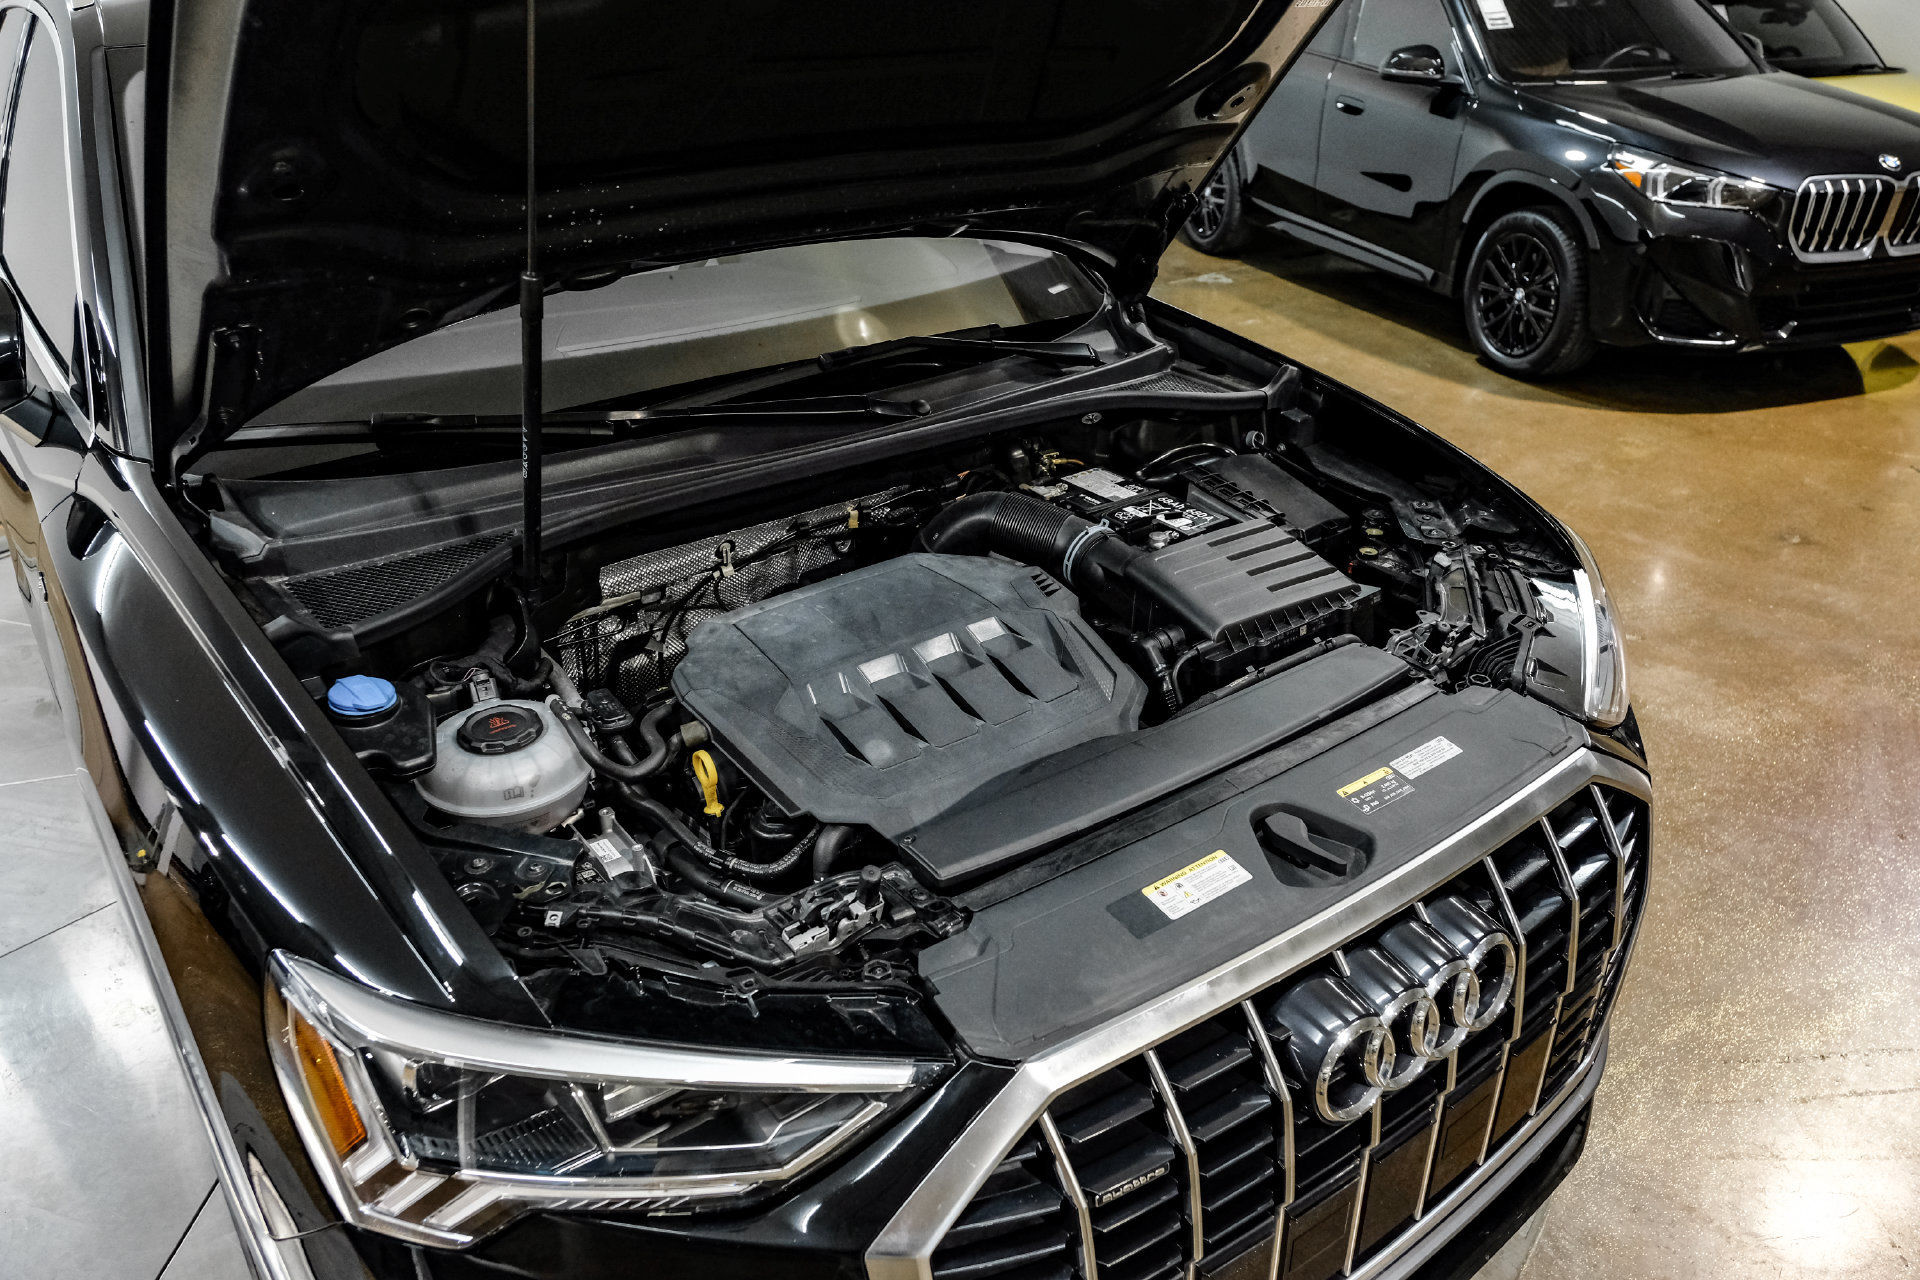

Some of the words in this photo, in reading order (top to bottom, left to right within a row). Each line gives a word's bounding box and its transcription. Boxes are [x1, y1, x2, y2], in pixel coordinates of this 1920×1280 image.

[1160, 871, 1187, 887] WARNING
[1188, 855, 1218, 872] ATTENTION
[1102, 1167, 1165, 1203] quattro
